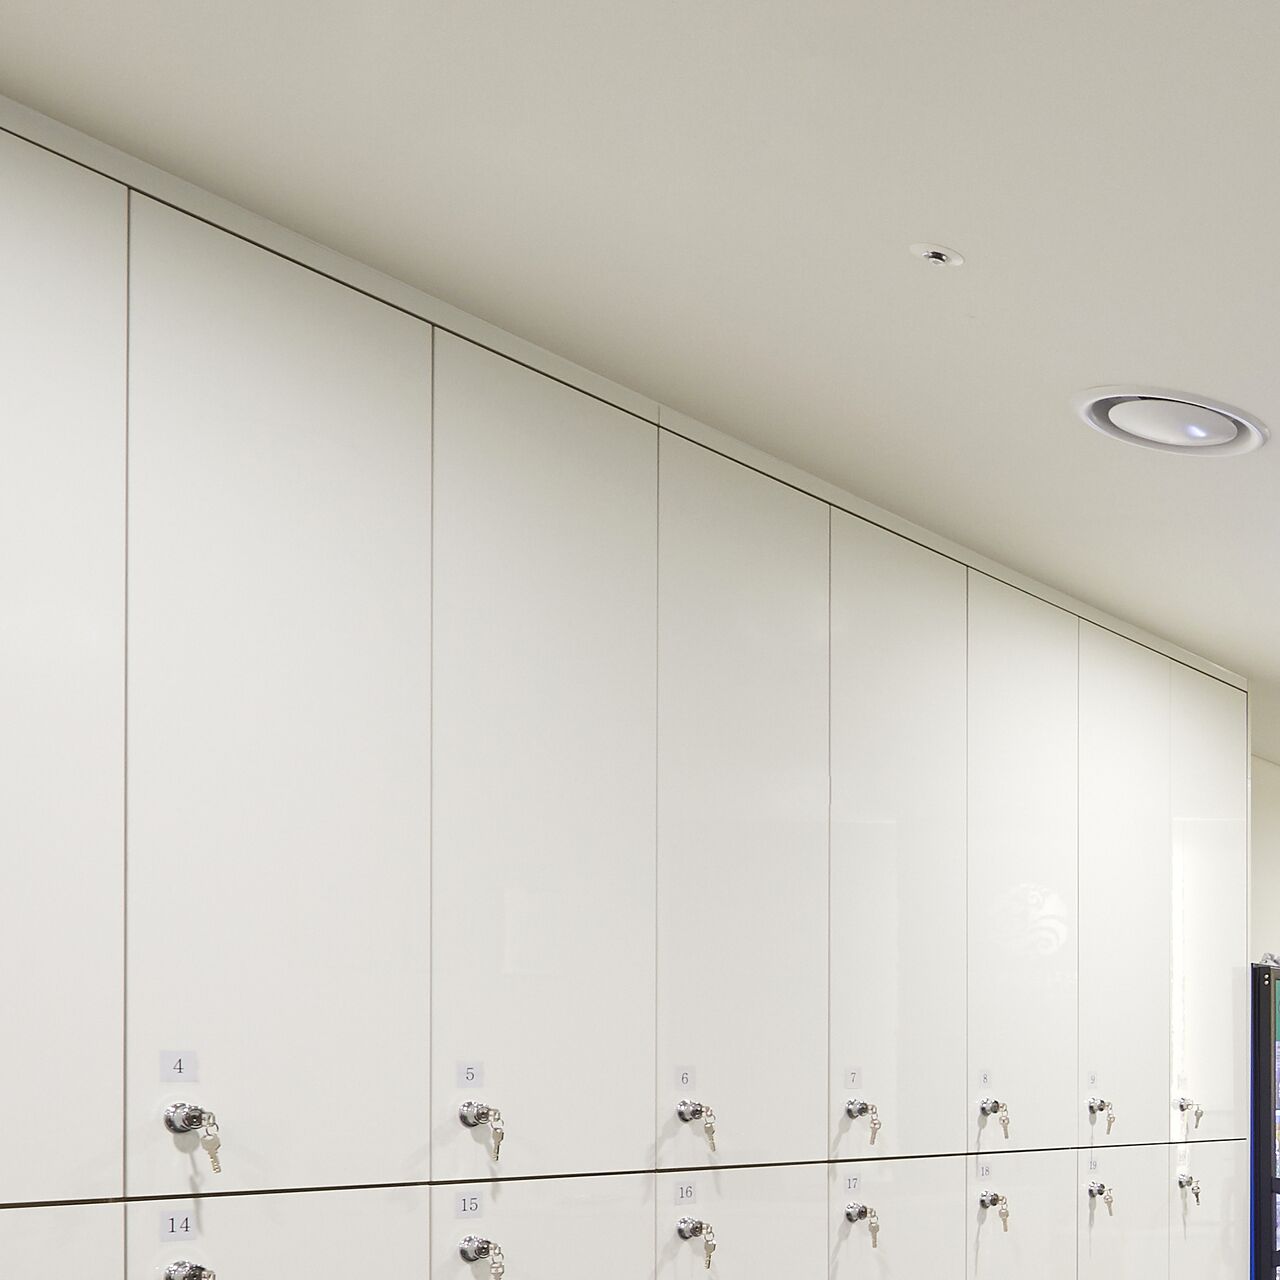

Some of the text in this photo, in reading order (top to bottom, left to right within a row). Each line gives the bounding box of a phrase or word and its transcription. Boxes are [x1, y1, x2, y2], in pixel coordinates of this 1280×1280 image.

[172, 1058, 185, 1073] 4
[465, 1065, 475, 1078] 5
[681, 1072, 690, 1085] 6
[850, 1072, 858, 1083] 7
[980, 1165, 990, 1178] 18
[847, 1177, 859, 1189] 17
[679, 1185, 693, 1199] 16
[461, 1197, 479, 1213] 15
[168, 1216, 191, 1233] 14
